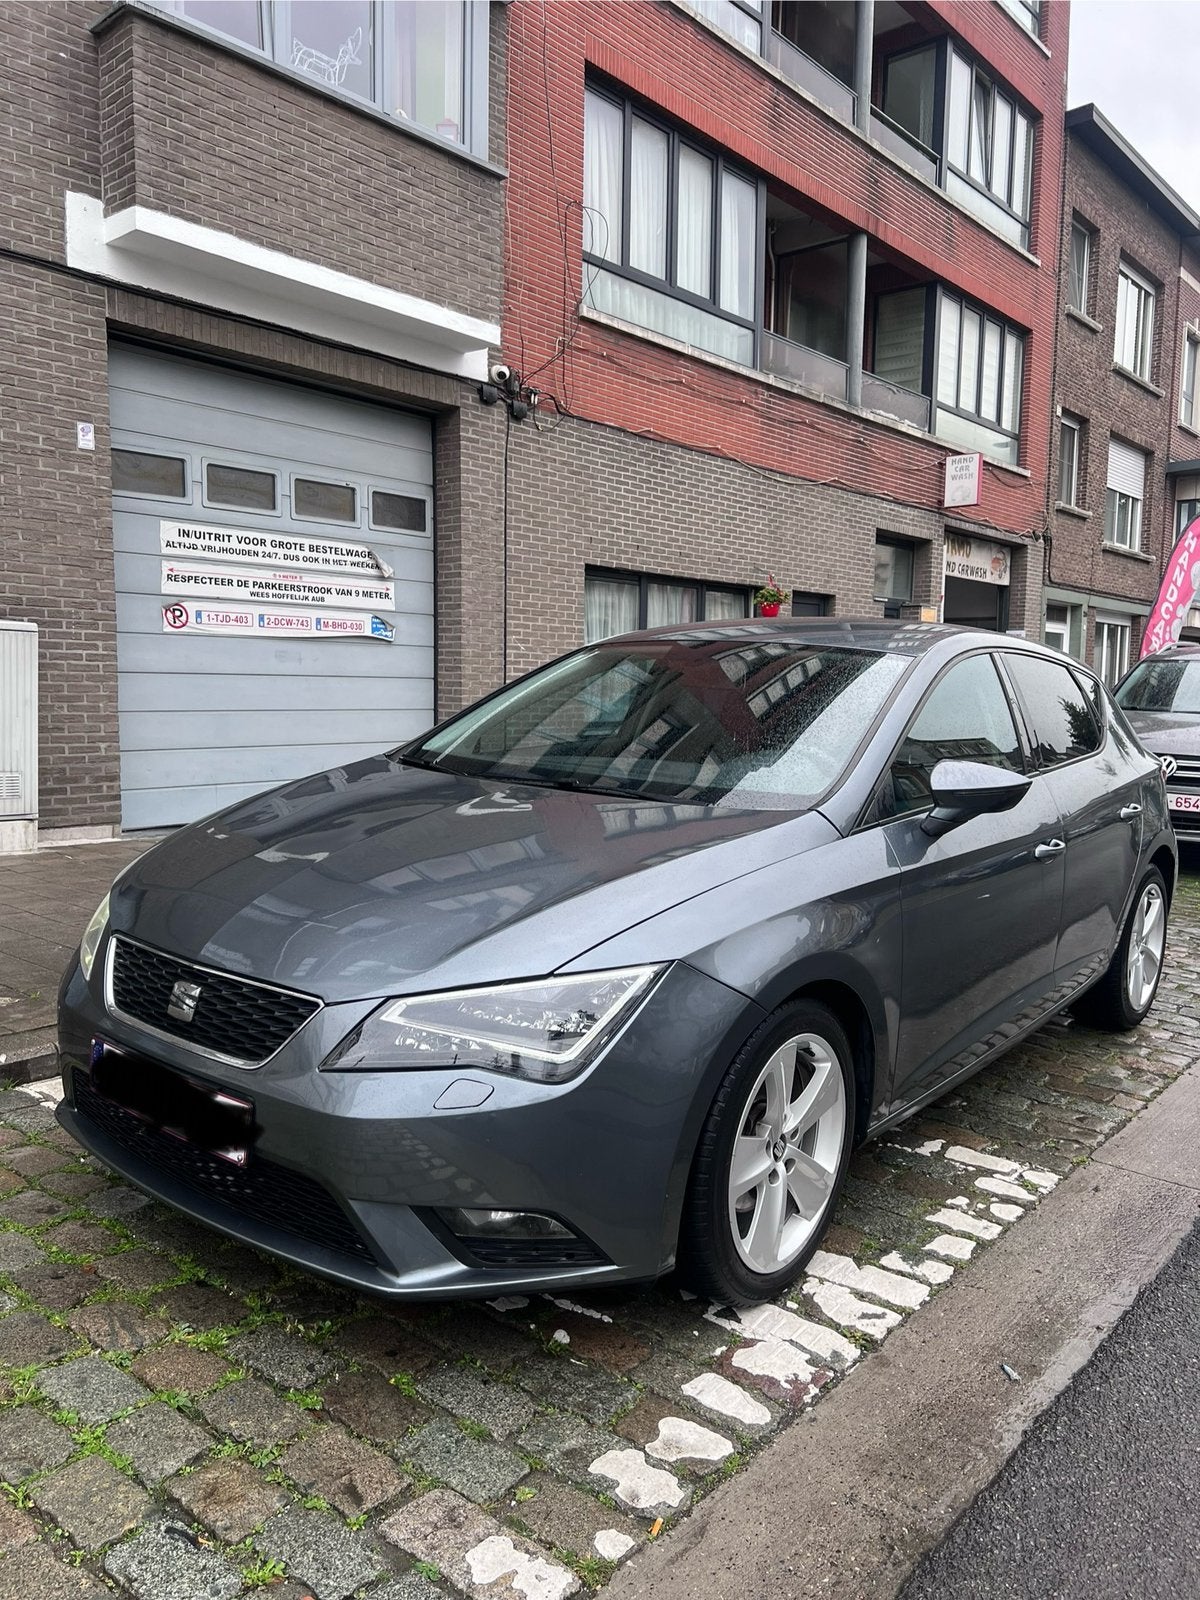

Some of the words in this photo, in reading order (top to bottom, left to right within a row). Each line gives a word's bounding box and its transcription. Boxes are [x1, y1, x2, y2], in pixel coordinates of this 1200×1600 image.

[951, 456, 974, 466] HAND
[178, 528, 232, 543] IN/UITRIT
[236, 535, 267, 547] VOOR
[270, 540, 305, 552] GROTE
[308, 544, 376, 560] BESTELWAGE
[165, 540, 198, 550] ALTIJD
[200, 544, 259, 557] VRIJHOUDEN
[262, 551, 281, 560] 24/7.
[283, 554, 300, 562] DUS
[302, 556, 320, 564] OOK
[350, 560, 382, 570] WEEKEN
[166, 574, 234, 586] RESPECTEER
[237, 580, 250, 588] DE
[252, 581, 332, 595] PARKEERSTROOK
[335, 588, 352, 596] VAN
[362, 590, 392, 600] METER.
[272, 592, 310, 602] HOFFELIJK
[206, 614, 248, 624] 1-TJD-403
[266, 617, 309, 628] 2-DCW-743
